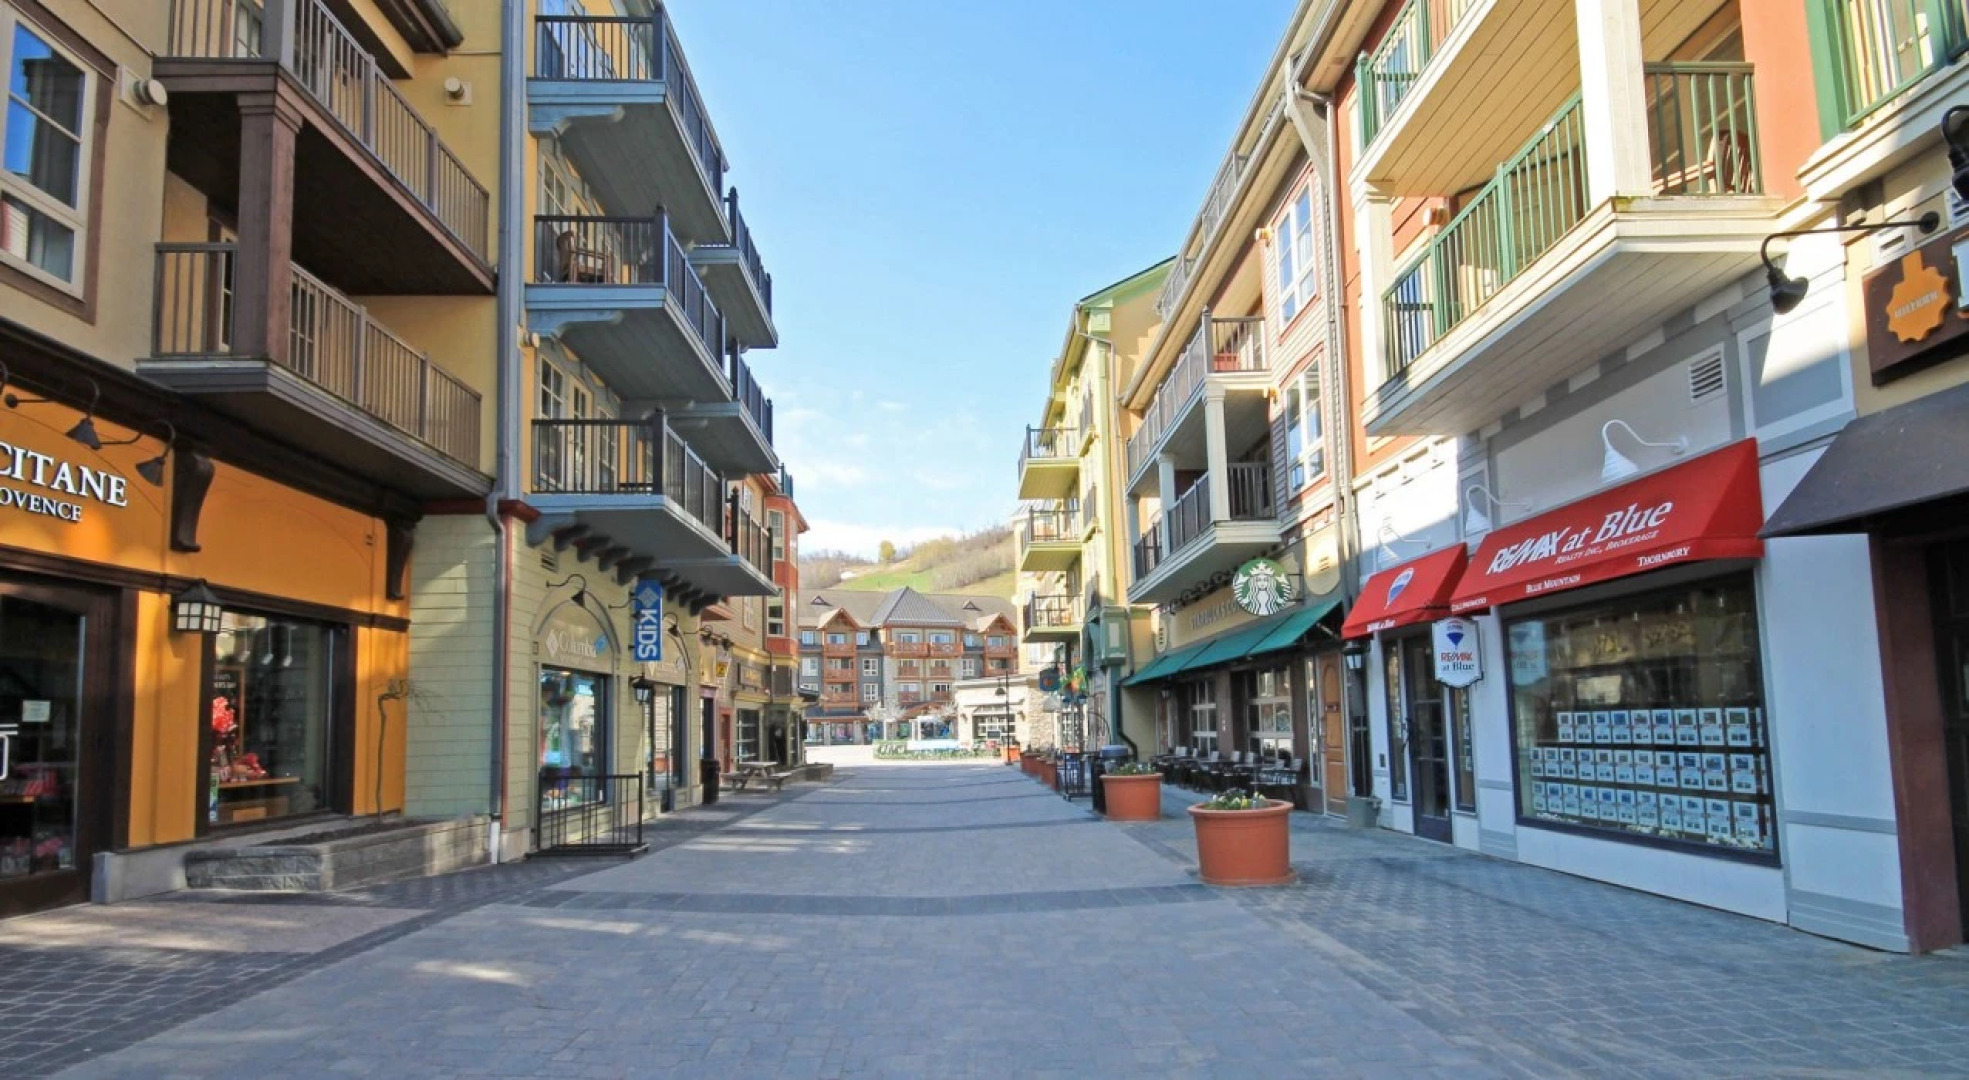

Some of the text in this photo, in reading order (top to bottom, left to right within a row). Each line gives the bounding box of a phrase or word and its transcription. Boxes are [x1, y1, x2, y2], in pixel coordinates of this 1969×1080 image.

[1486, 502, 1673, 575] RE/MAX at Blue
[1637, 546, 1690, 567] THORNBURY
[1526, 574, 1580, 594] BLUE MOUNTAIN
[638, 609, 658, 658] KIDS
[1453, 662, 1475, 671] Blue
